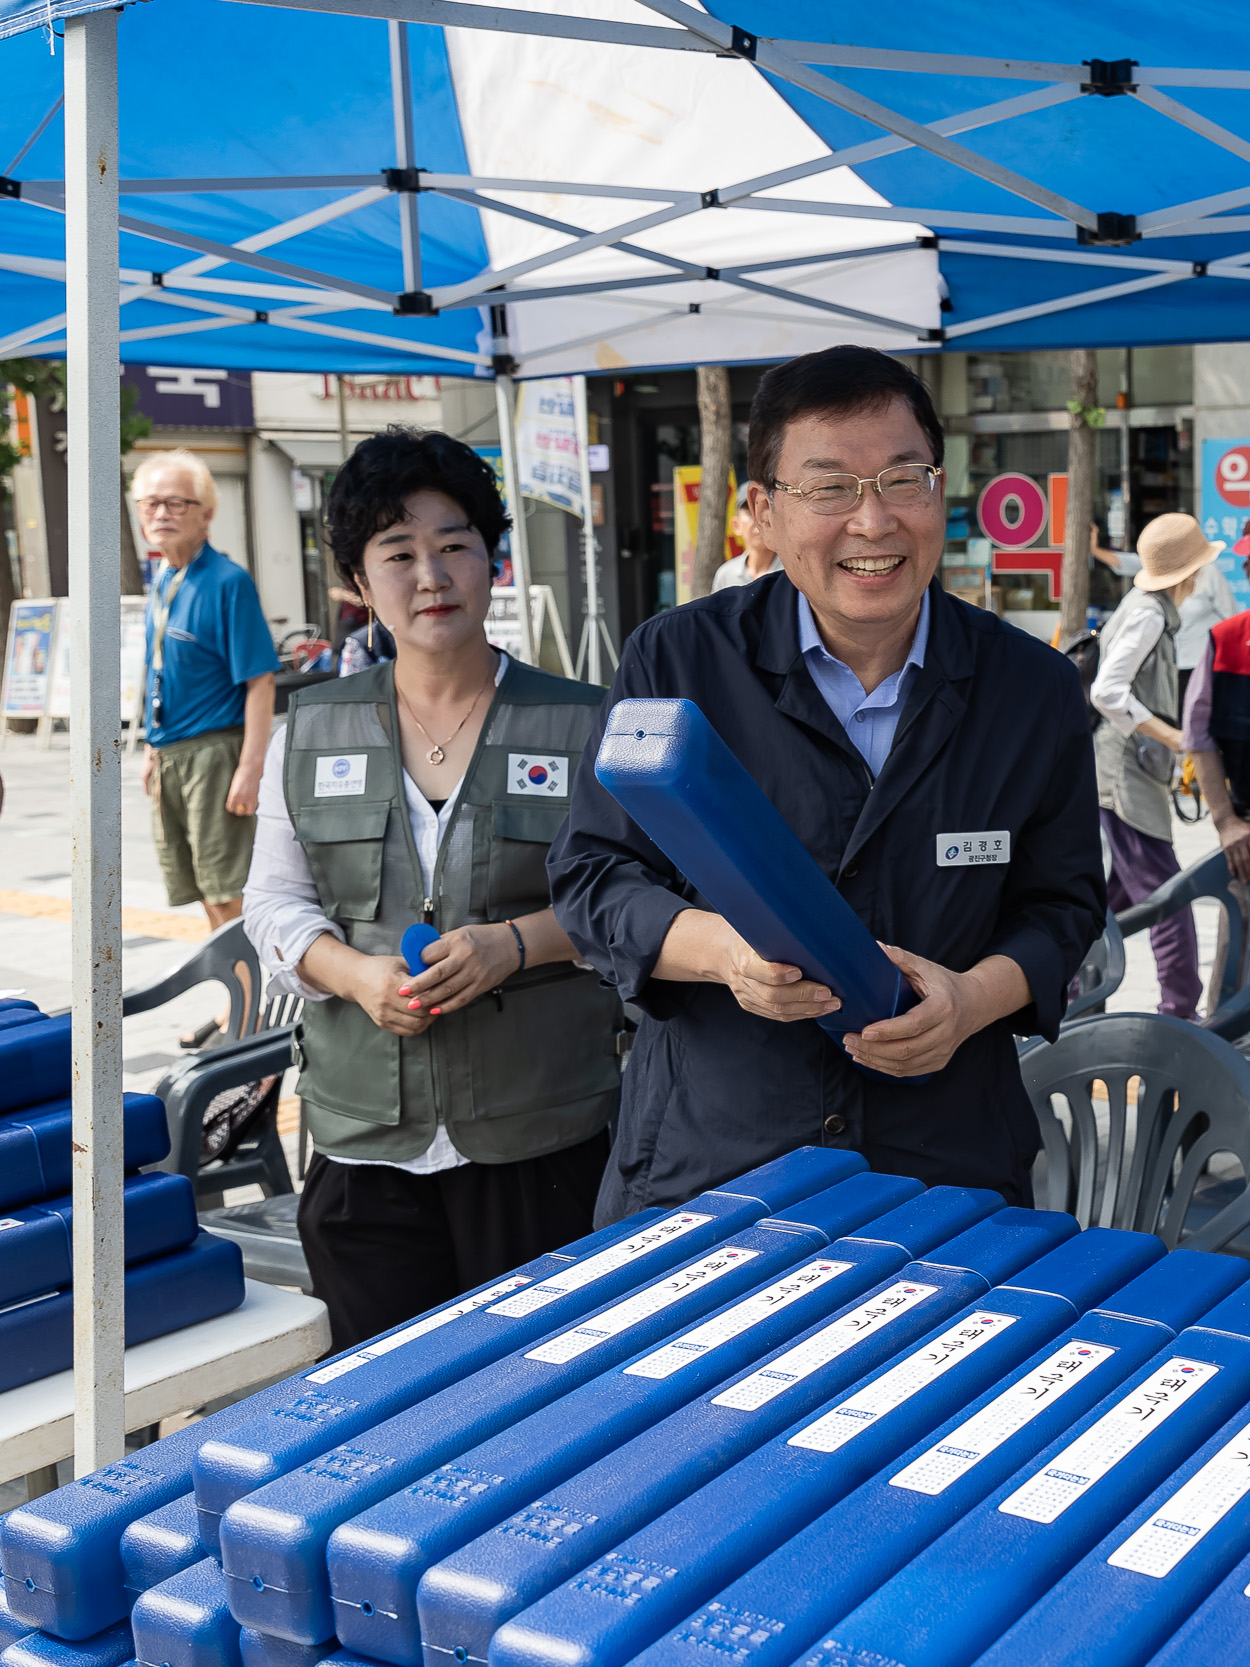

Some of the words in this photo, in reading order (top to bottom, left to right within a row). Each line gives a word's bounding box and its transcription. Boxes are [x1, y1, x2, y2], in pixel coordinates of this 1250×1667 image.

[759, 1274, 821, 1305] 태극기
[843, 1297, 906, 1331] 태극기
[921, 1329, 985, 1365] 태극기
[1019, 1360, 1083, 1400] 태극기
[1124, 1378, 1187, 1420] 태극기
